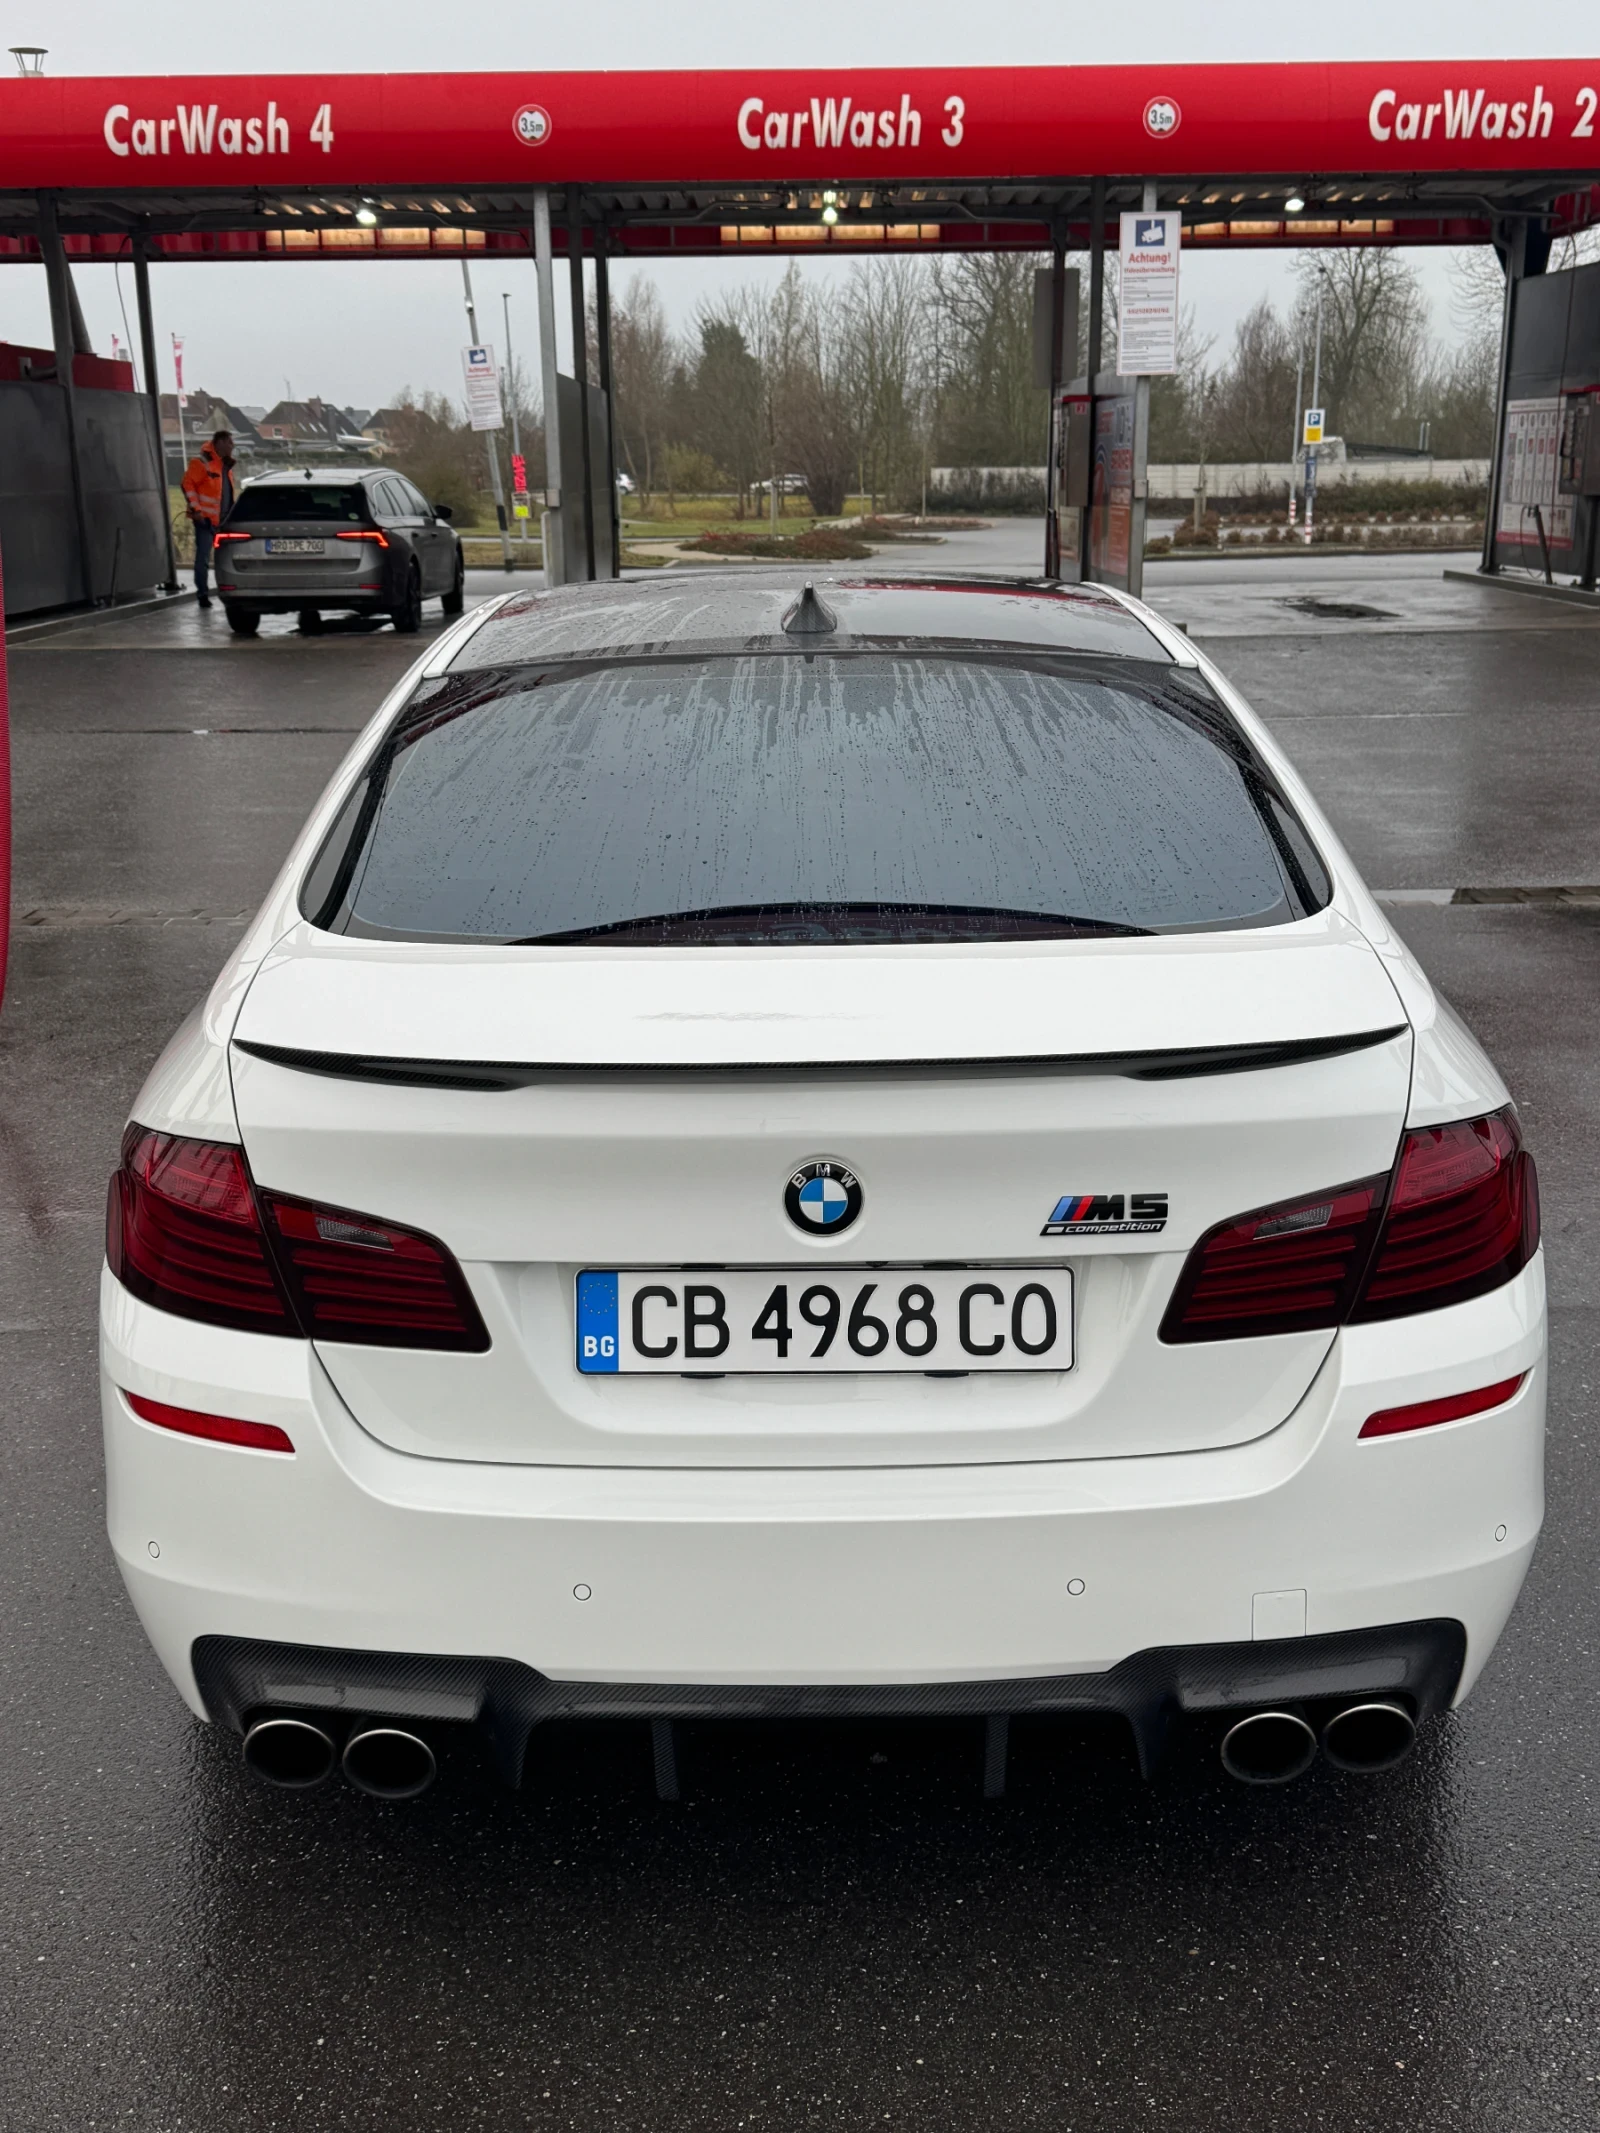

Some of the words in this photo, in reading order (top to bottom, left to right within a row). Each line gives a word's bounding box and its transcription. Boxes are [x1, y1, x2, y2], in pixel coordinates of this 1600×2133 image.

[103, 101, 290, 157] CarWash
[309, 103, 335, 153] 4
[737, 93, 922, 150] CarWash
[941, 95, 966, 148] 3
[1368, 85, 1554, 142] CarWash
[1570, 86, 1598, 138] 2
[1128, 252, 1171, 265] Achtung!
[791, 1163, 857, 1189] BMW
[1065, 1222, 1161, 1234] competition
[632, 1285, 730, 1358] CB
[751, 1284, 938, 1358] 4968
[584, 1336, 615, 1357] BG
